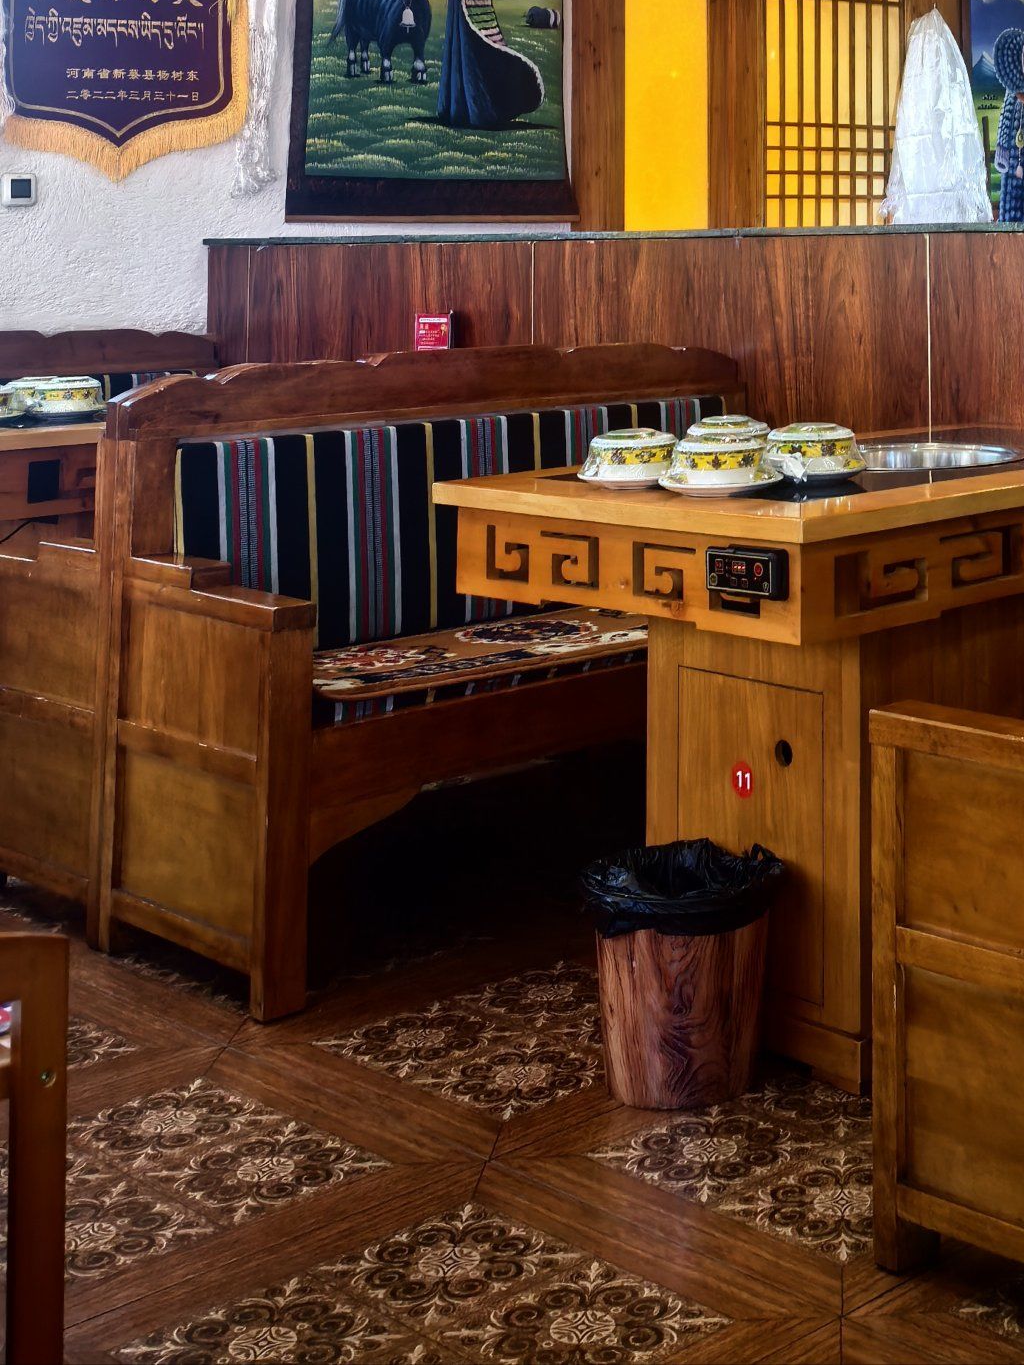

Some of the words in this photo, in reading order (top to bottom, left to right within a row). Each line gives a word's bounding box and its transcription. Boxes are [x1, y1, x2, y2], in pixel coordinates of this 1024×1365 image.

[65, 88, 199, 102] 二零二二年三月三十一日
[736, 770, 751, 791] 11
